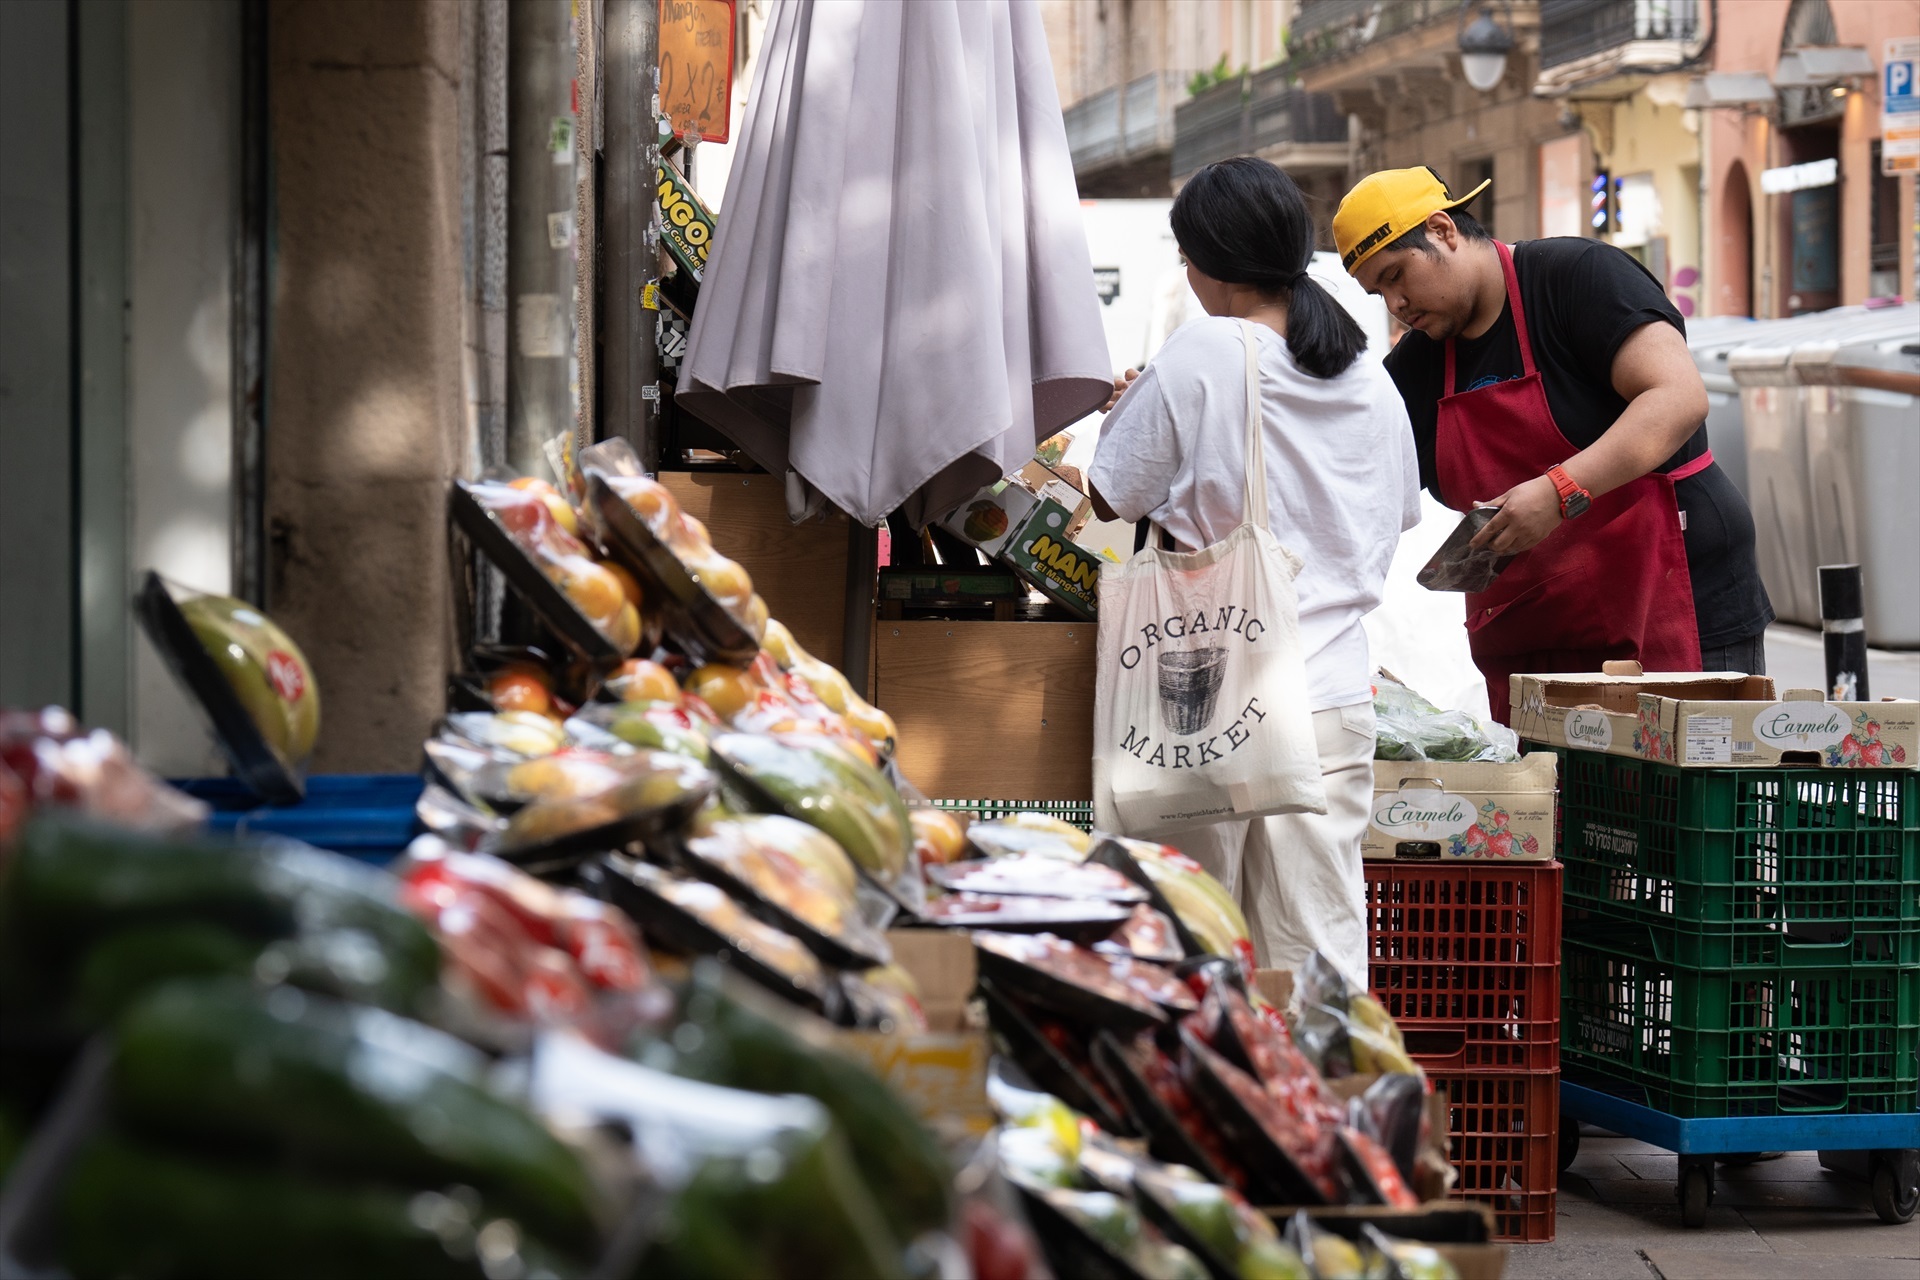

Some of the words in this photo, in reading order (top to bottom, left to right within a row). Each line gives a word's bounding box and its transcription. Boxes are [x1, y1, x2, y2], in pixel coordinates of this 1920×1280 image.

[1890, 63, 1909, 95] P
[1029, 535, 1099, 591] MAN
[1046, 570, 1077, 594] Mango
[1120, 605, 1265, 669] ORGANIC
[1120, 697, 1266, 769] MARKET
[1569, 714, 1605, 739] Carmelo
[1760, 713, 1841, 739] Carmelo
[1375, 801, 1466, 827] Carmelo
